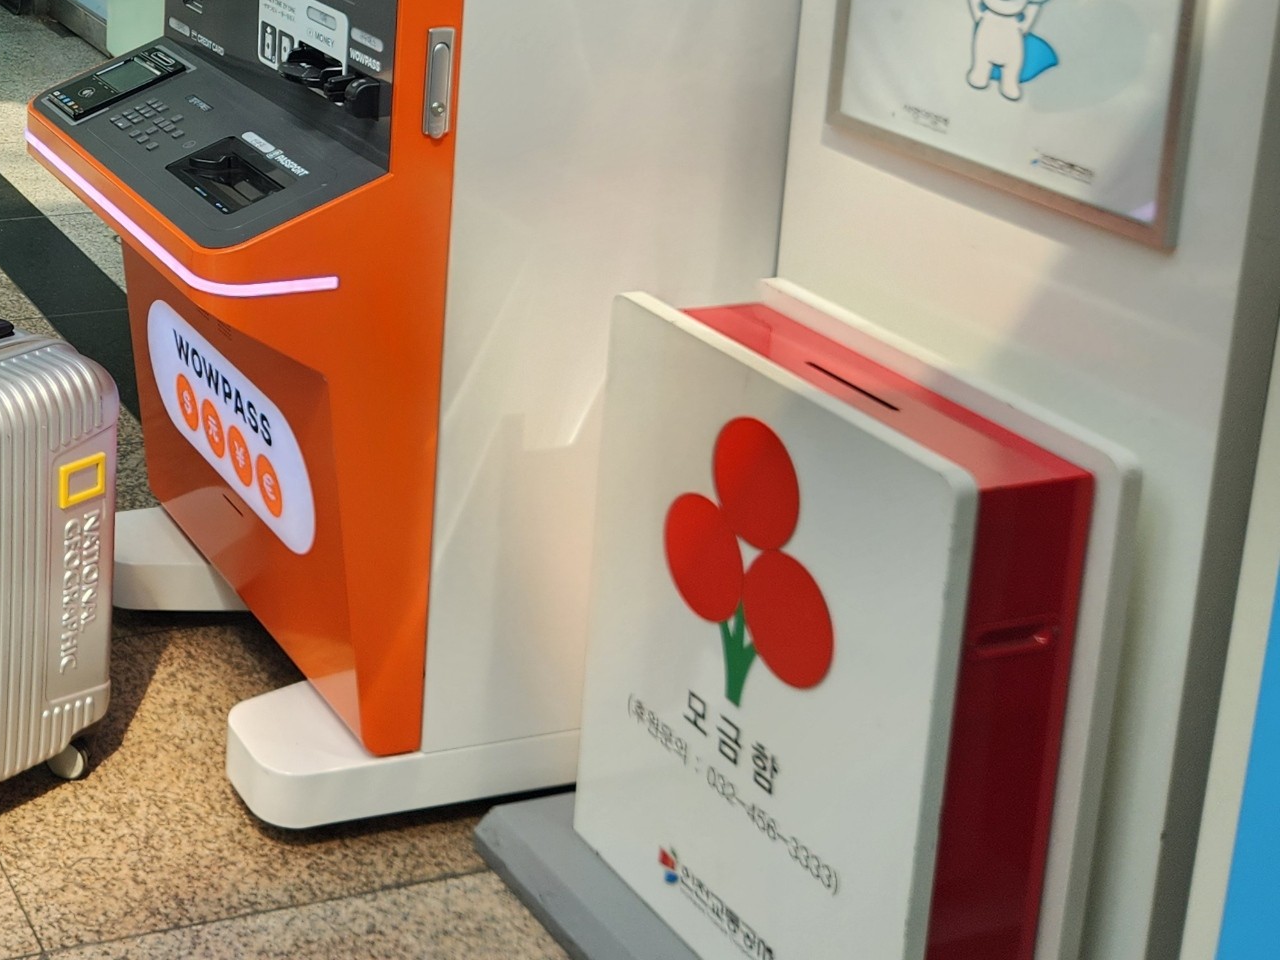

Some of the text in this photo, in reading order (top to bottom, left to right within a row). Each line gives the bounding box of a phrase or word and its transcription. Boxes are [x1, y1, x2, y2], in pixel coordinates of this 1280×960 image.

[197, 34, 225, 57] CREDIT CARD
[314, 31, 334, 48] MONEY
[349, 47, 382, 72] WOWPASS
[275, 154, 310, 177] PASSPORT
[172, 328, 273, 447] WOWPASS
[60, 518, 82, 674] GEOGRAPHIC
[81, 508, 100, 633] NATIONAL
[683, 689, 780, 795] 모금함
[707, 765, 839, 896] 032-456-3333)
